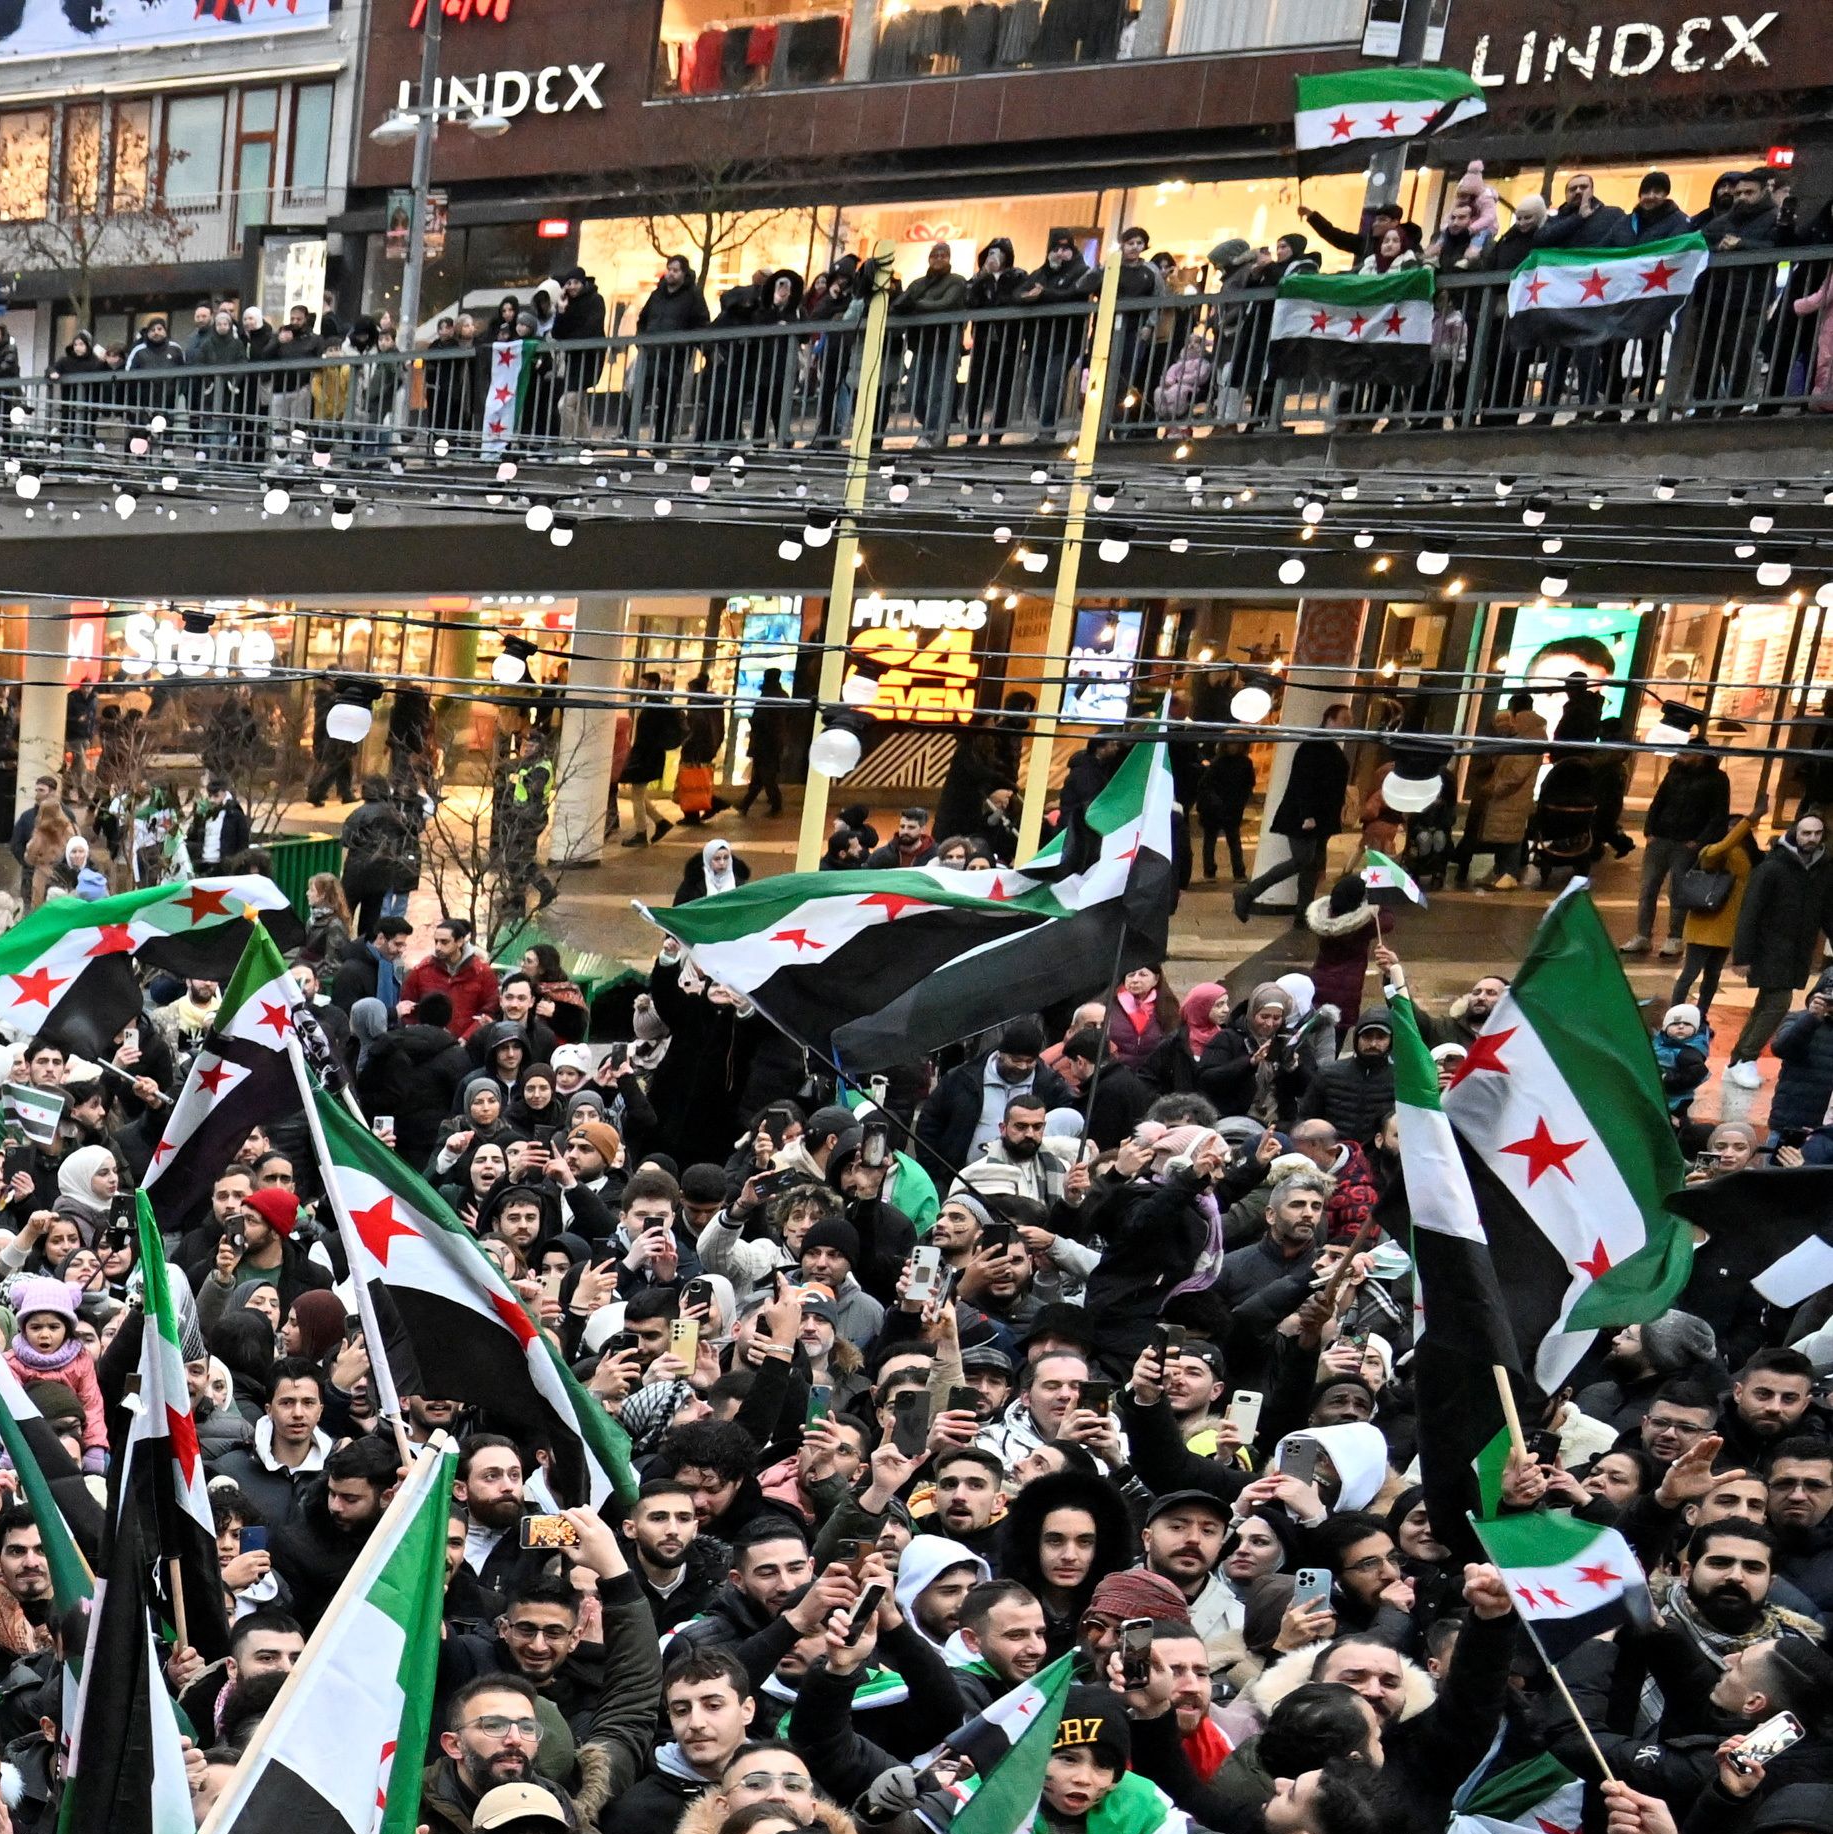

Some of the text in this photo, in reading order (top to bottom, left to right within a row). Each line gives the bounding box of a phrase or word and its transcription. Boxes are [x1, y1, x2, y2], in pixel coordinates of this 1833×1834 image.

[1471, 11, 1780, 87] LINDEX
[398, 62, 606, 124] LINDEX
[120, 612, 275, 677] Store
[851, 598, 988, 630] FITNESS
[846, 626, 979, 688] 24
[855, 686, 976, 723] EVEN
